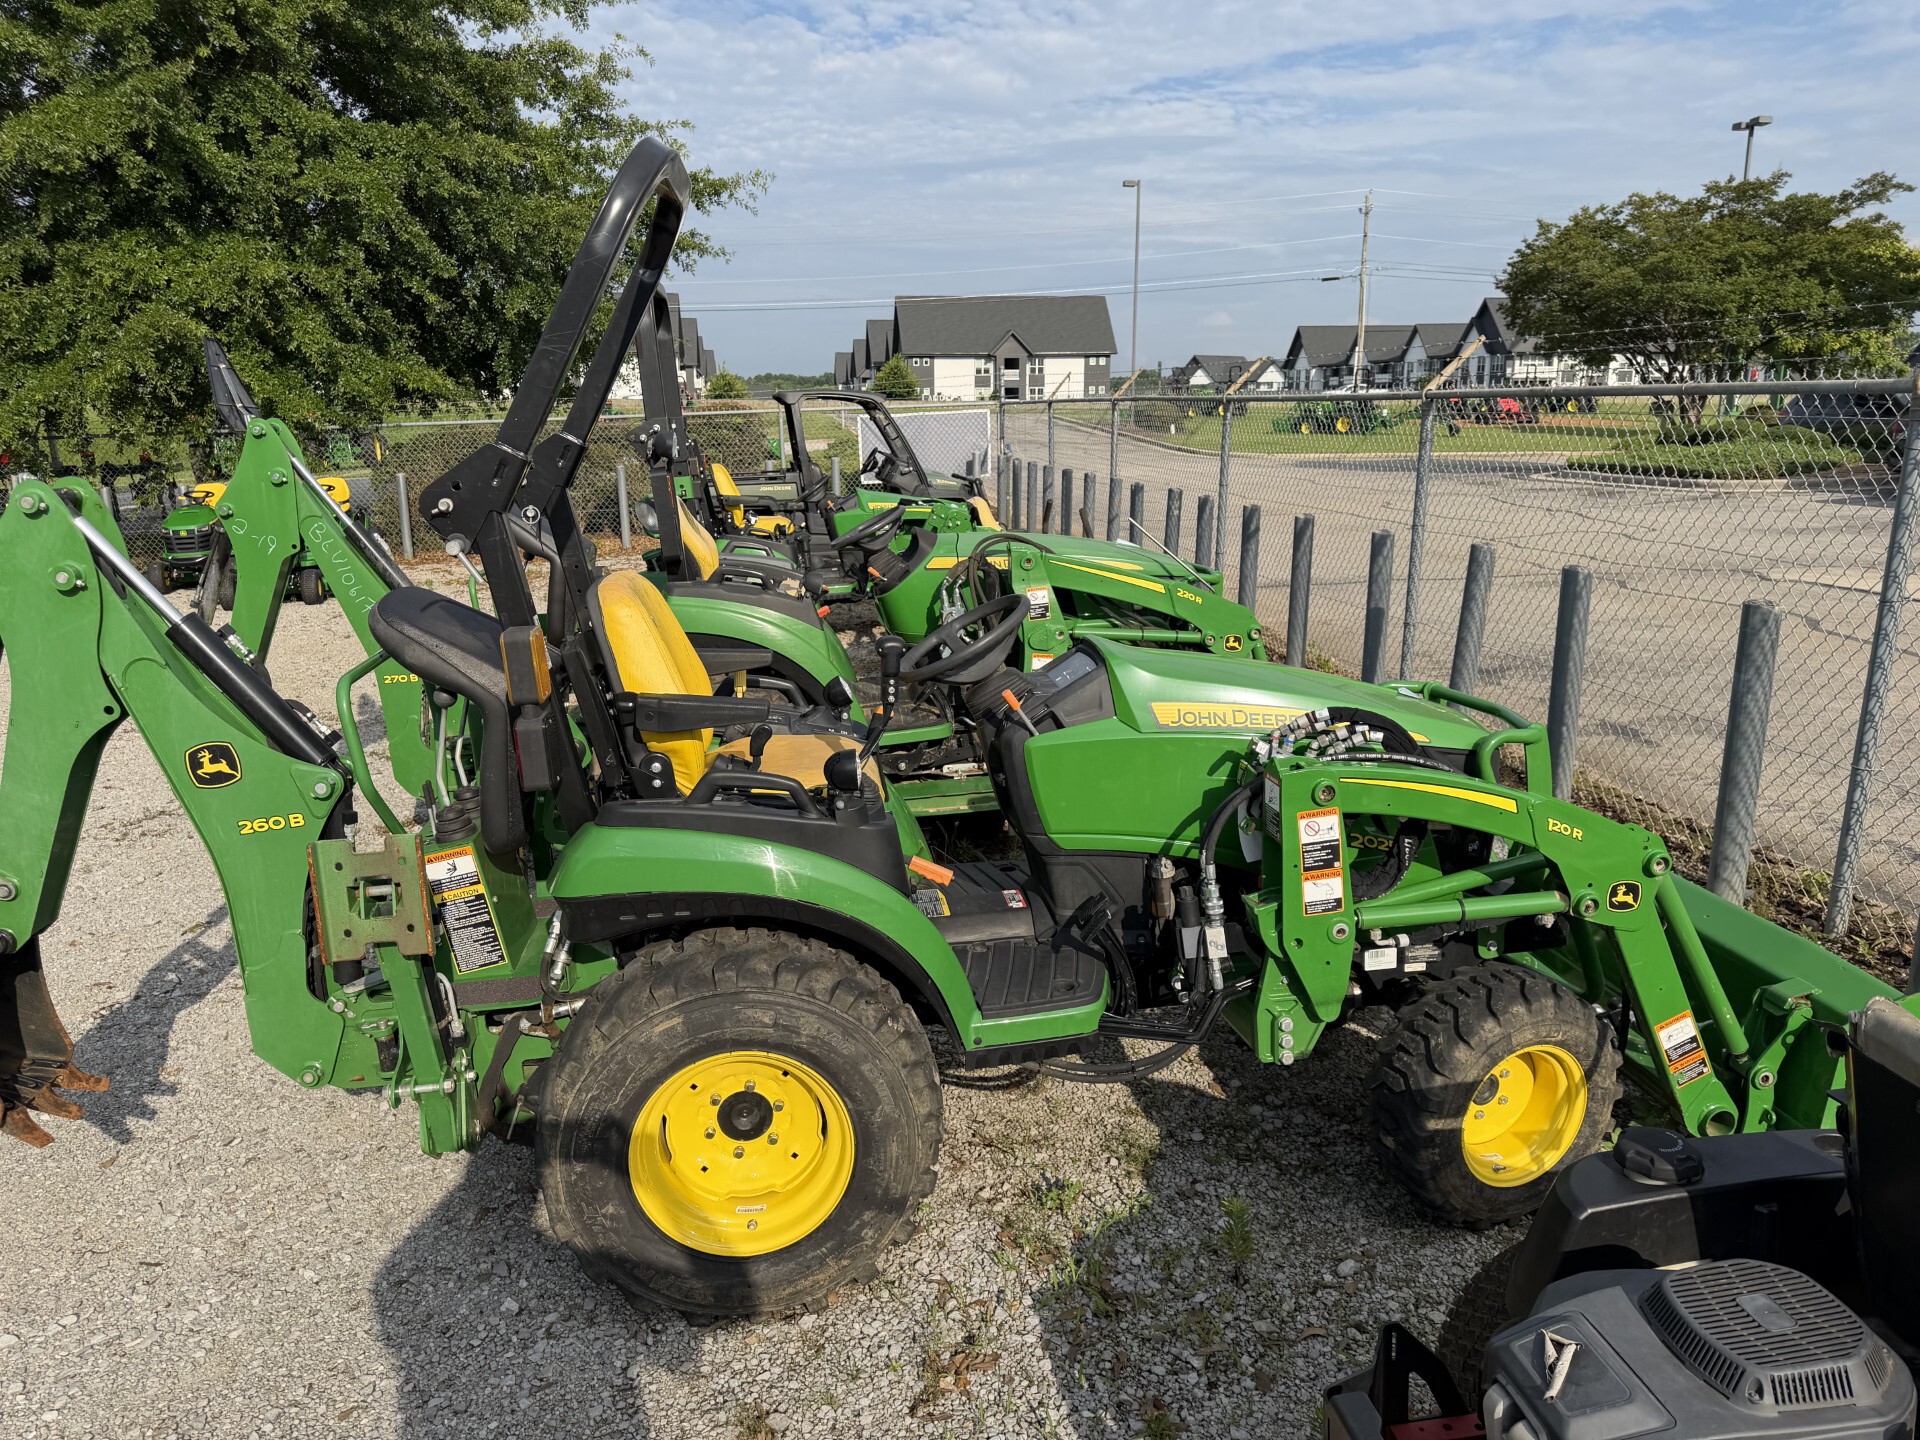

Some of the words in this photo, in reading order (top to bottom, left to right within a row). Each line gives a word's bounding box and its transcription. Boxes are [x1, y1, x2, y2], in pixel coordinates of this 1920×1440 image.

[1176, 587, 1196, 601] 220
[1195, 595, 1203, 605] R
[383, 674, 408, 684] 270
[409, 673, 419, 682] B
[1170, 708, 1228, 725] JOHN
[1305, 809, 1337, 819] WARNING
[237, 816, 286, 835] 260
[287, 813, 306, 828] B
[1547, 817, 1572, 836] 120
[1572, 827, 1583, 841] R
[433, 849, 468, 863] WARNING
[1309, 871, 1341, 880] WARNING
[447, 888, 479, 901] CAUTION
